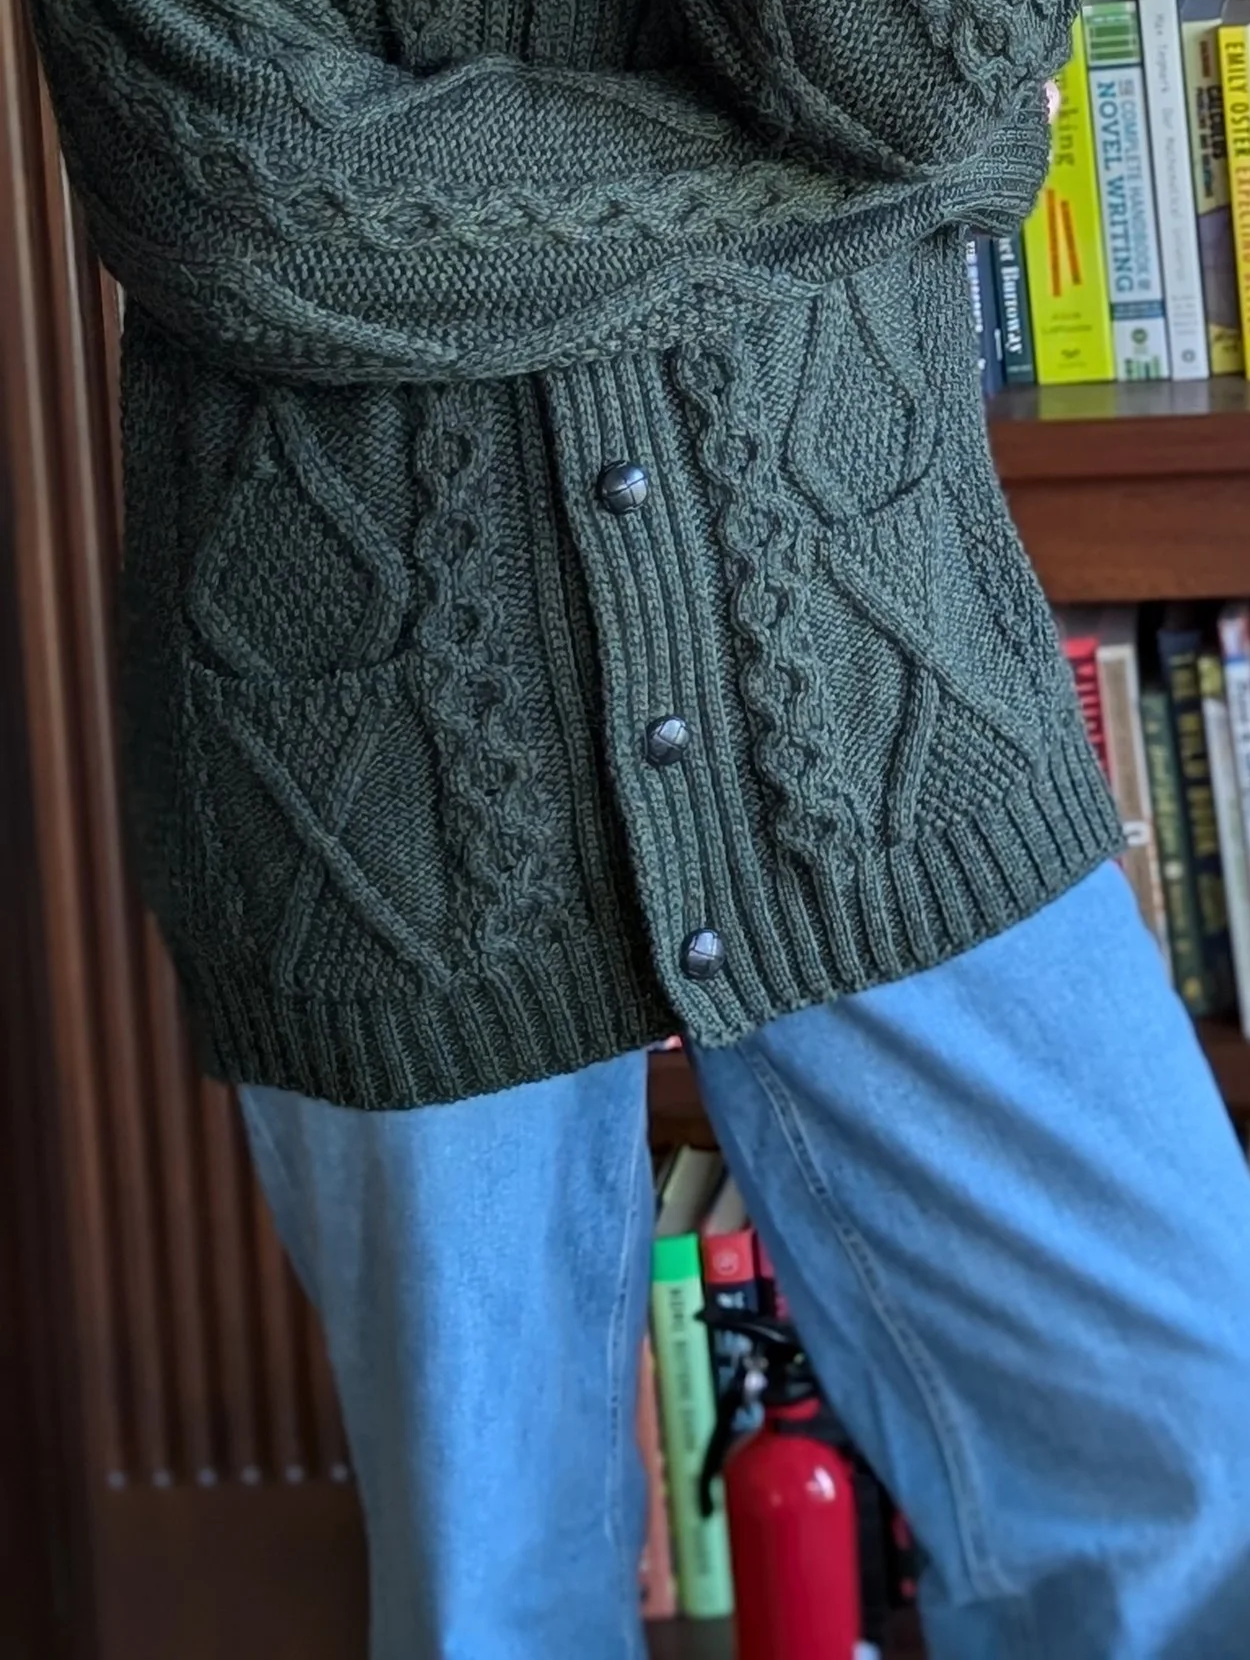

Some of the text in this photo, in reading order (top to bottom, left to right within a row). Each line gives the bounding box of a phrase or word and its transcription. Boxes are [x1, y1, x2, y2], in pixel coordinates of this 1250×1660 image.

[1156, 42, 1172, 94] Tegmark
[1223, 42, 1249, 95] EMILY
[1206, 84, 1224, 160] CALCULUS
[1096, 81, 1134, 294] NOVEL WRITING
[1120, 100, 1153, 275] COMPLETE HANDBOOK
[1163, 137, 1183, 219] Mathematical
[1171, 226, 1187, 282] Universe
[1000, 261, 1027, 355] Burroway
